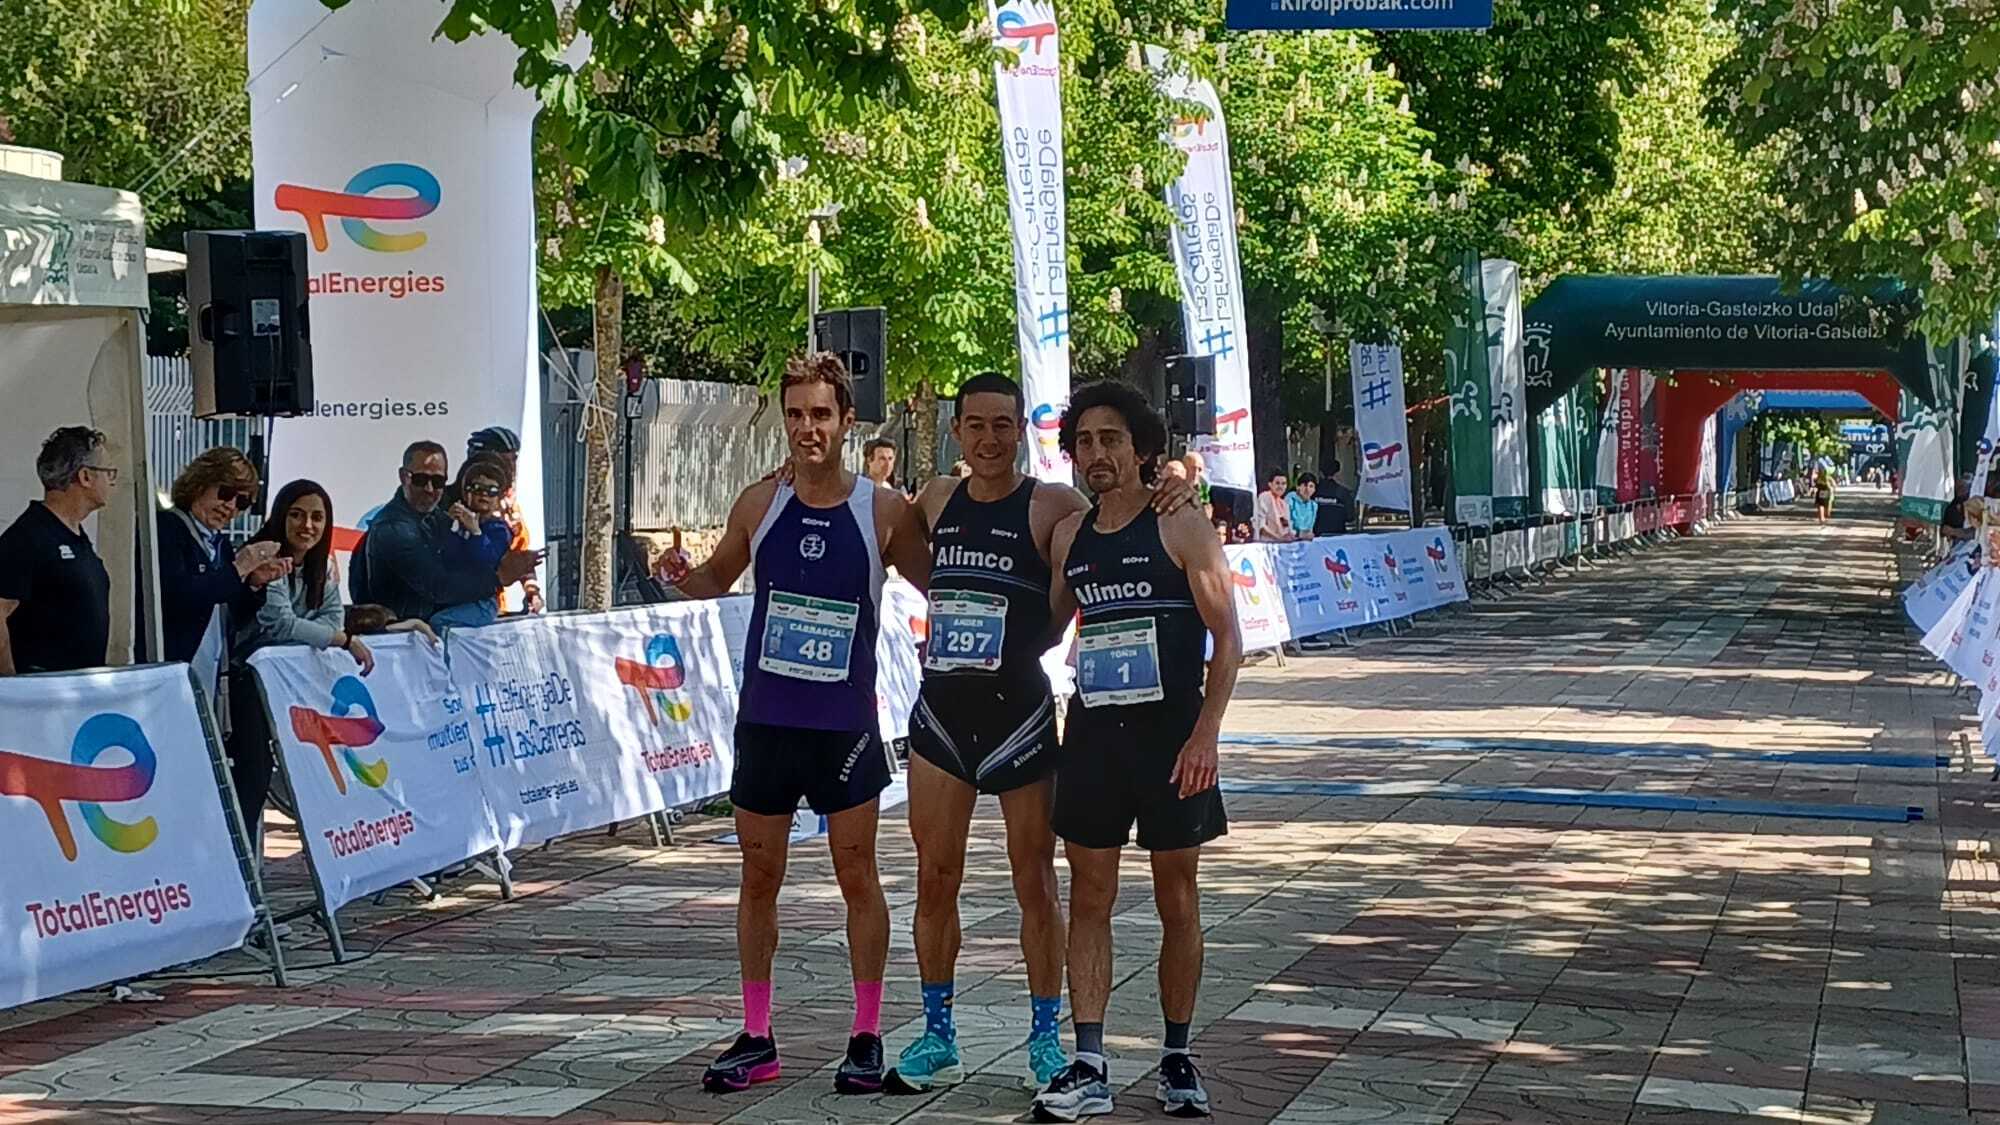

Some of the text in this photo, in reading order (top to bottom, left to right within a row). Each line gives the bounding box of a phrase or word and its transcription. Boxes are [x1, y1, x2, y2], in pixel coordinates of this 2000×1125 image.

[307, 270, 445, 298] alEnergies
[1646, 301, 1842, 317] Vitoria-Gasteizko Udal
[1605, 322, 1722, 341] Ayuntamiento
[1727, 323, 1749, 340] de
[936, 545, 1014, 572] Alimco
[798, 638, 833, 661] 48
[946, 630, 993, 653] 297
[1117, 661, 1130, 684] 1
[505, 719, 587, 760] LasCarreras
[323, 808, 415, 859] TotalEnergies
[26, 877, 192, 939] TotalEnergies
